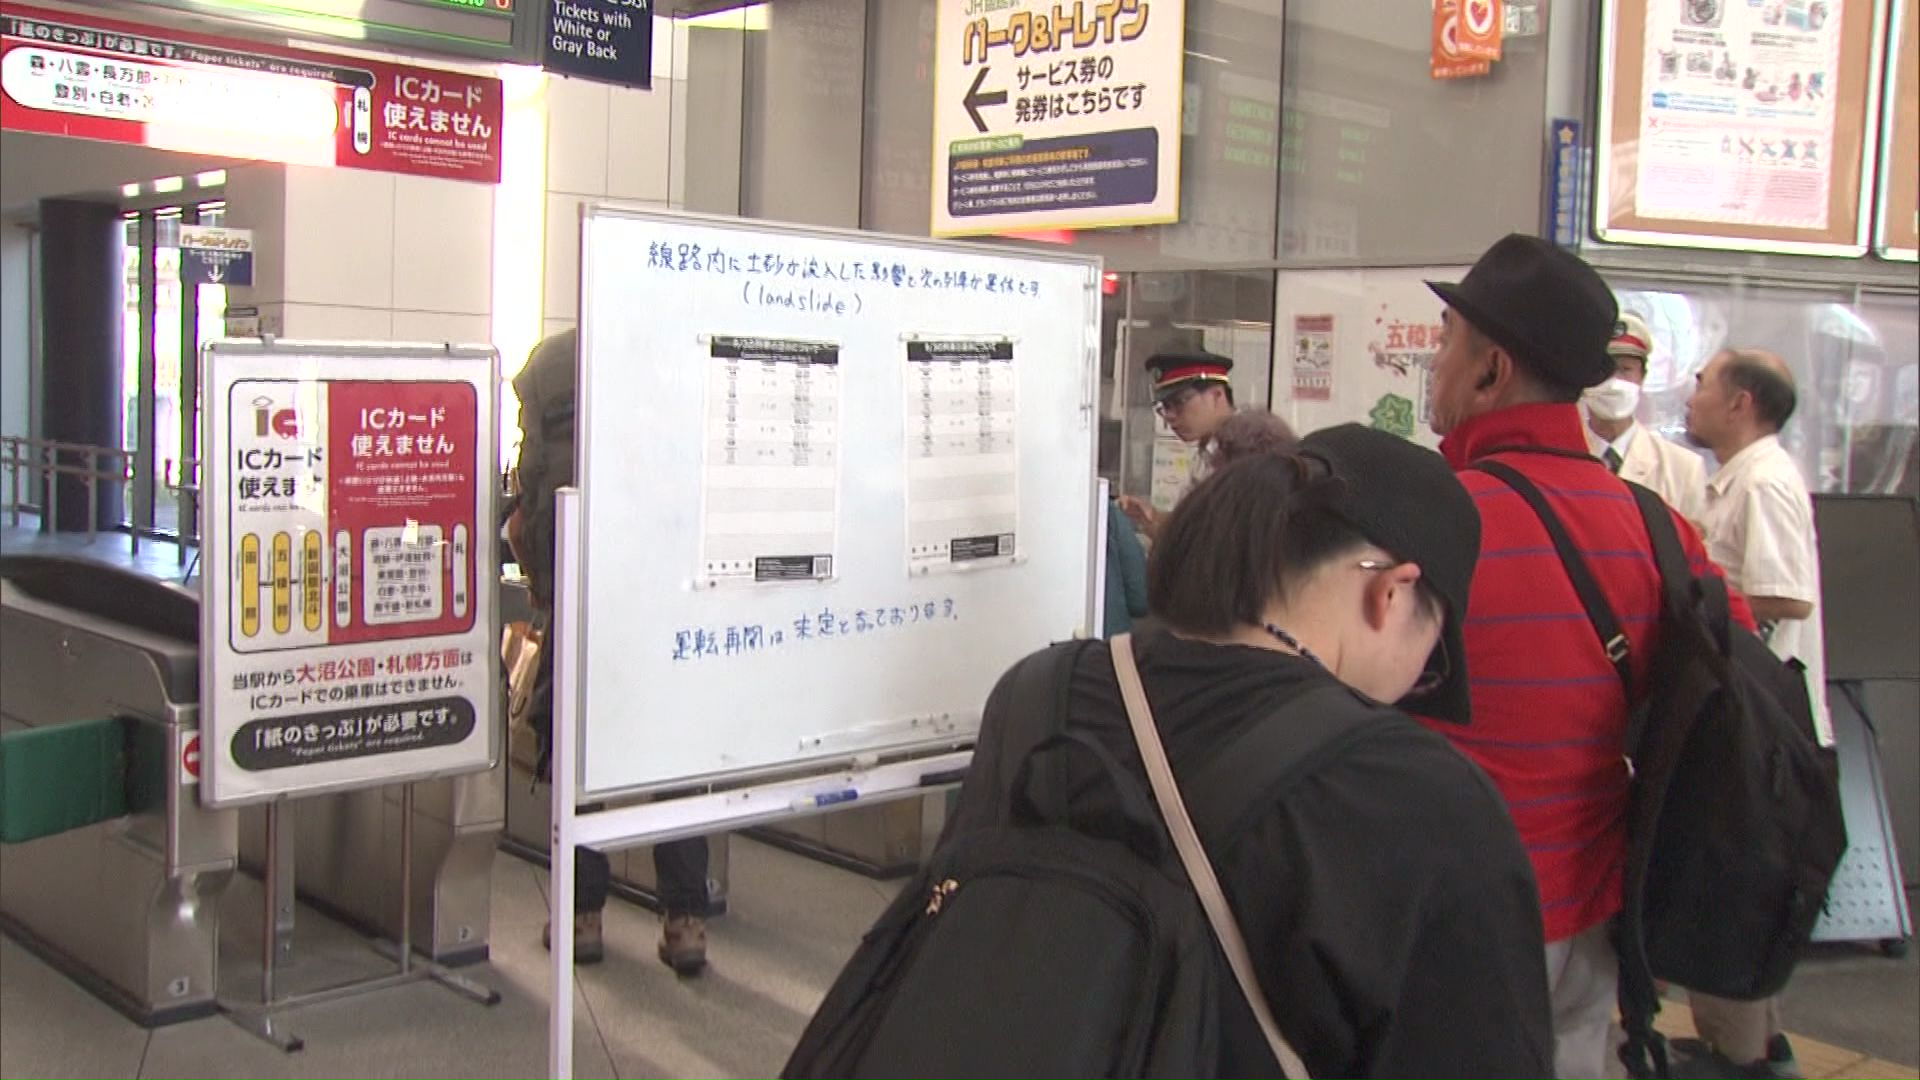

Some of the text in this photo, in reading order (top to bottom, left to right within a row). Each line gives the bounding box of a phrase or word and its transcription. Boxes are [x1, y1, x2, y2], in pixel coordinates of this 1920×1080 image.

[553, 16, 610, 42] White or
[555, 0, 599, 23] Tickets
[603, 11, 632, 30] with
[553, 35, 618, 61] Gray Back
[1015, 55, 1114, 91] サービス券の
[394, 74, 483, 109] ICカード
[1015, 82, 1147, 123] 発券はこちらです
[383, 100, 492, 138] 使えません
[361, 406, 446, 430] ICカード
[238, 447, 323, 471] ICカード
[351, 434, 455, 458] 使えません
[232, 648, 472, 690] 当駅から大沼公園・札幌方面は
